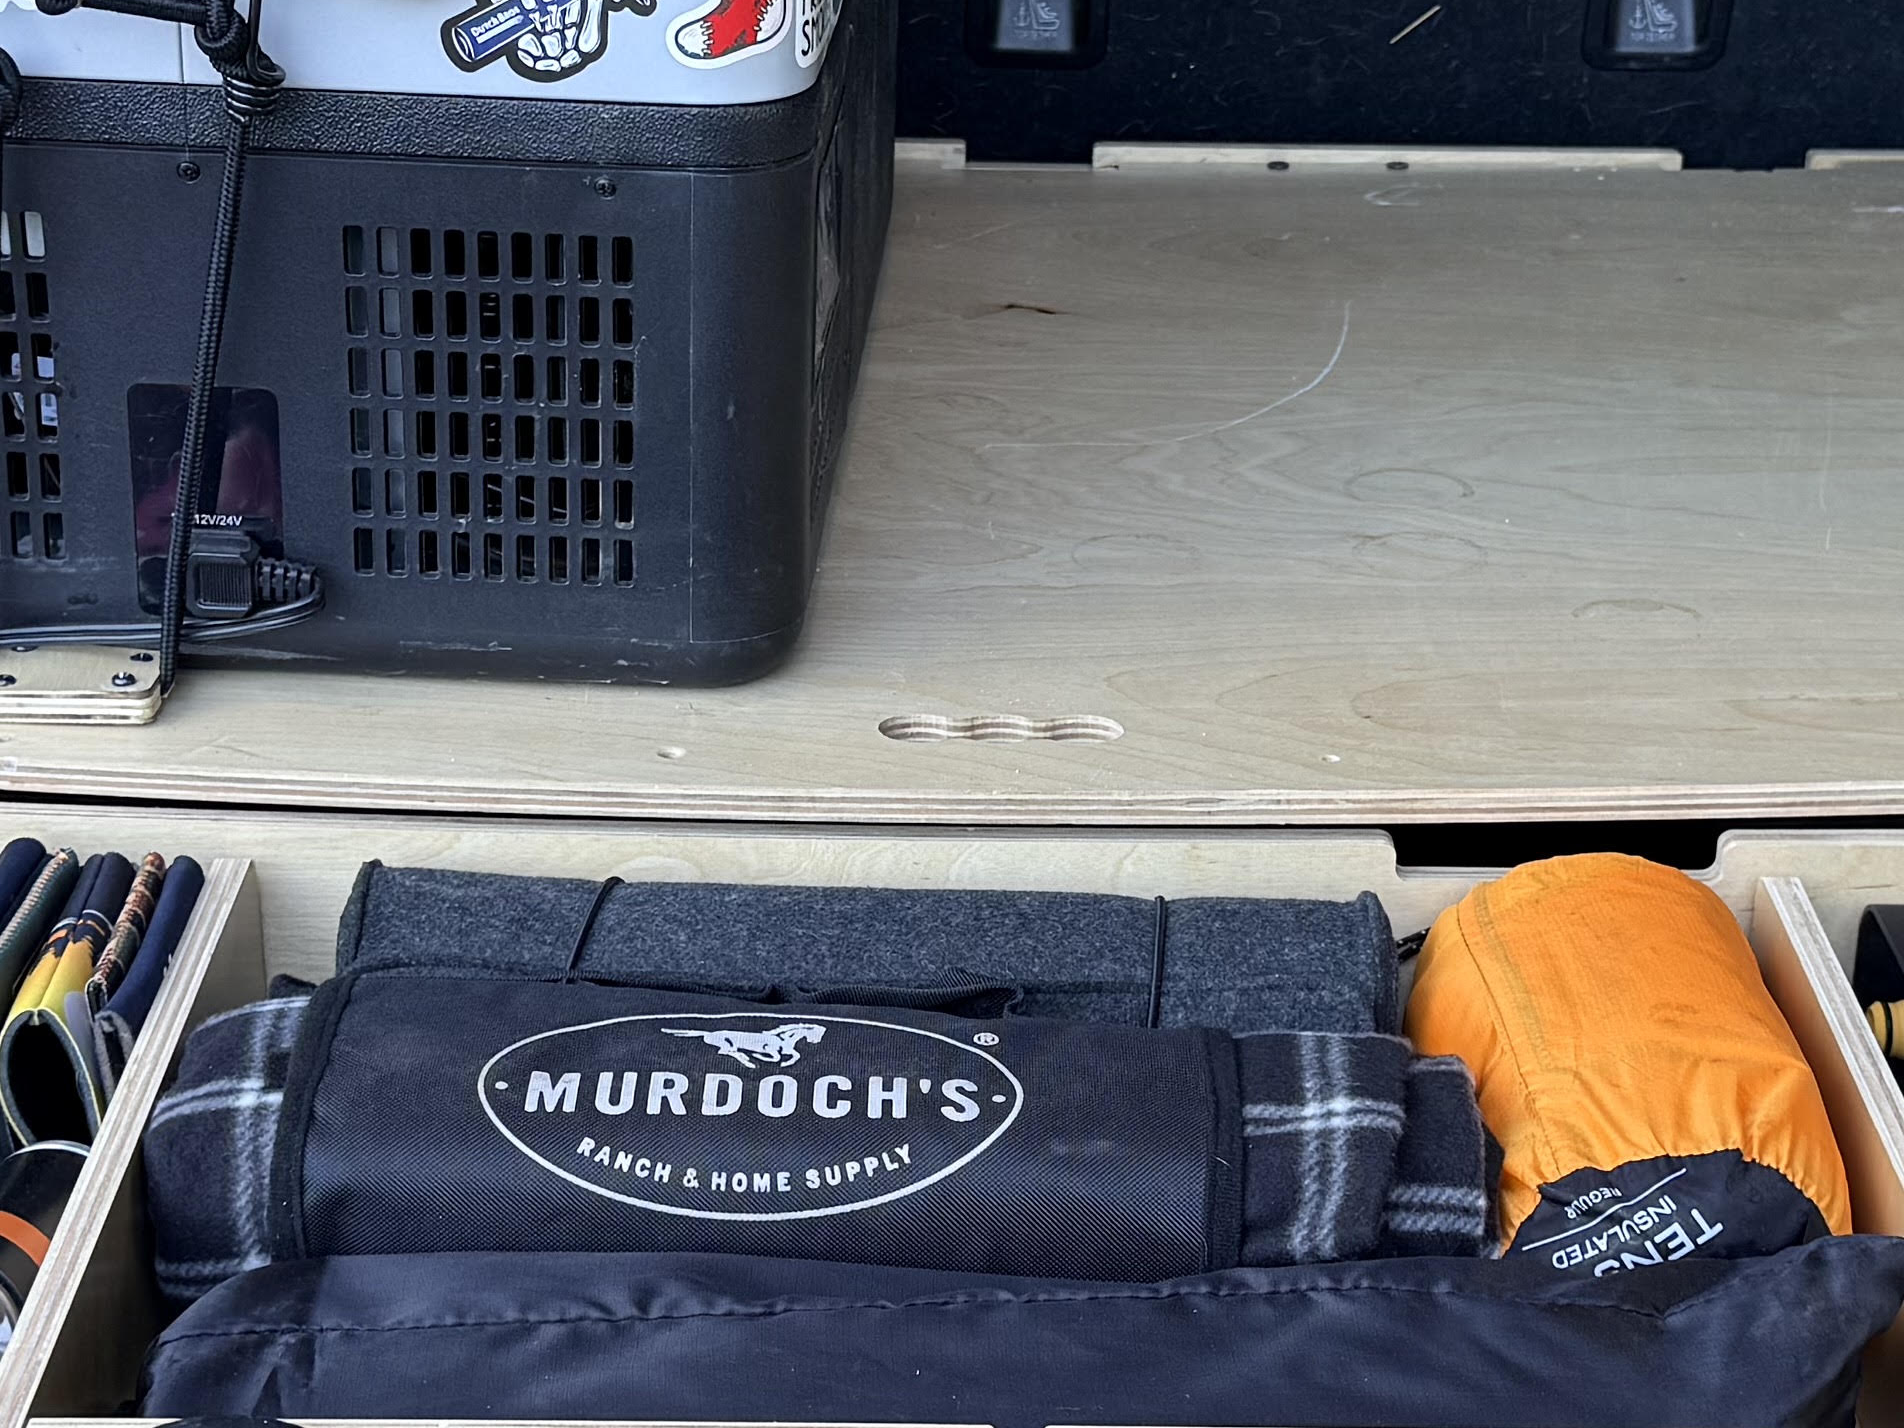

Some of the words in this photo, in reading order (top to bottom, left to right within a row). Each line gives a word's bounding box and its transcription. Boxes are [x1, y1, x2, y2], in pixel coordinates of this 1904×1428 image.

[524, 1070, 981, 1122] MURDOCH'S
[576, 1136, 670, 1184] RANCH
[682, 1167, 700, 1188] &
[711, 1170, 792, 1193] HOME
[804, 1144, 913, 1190] SUPPLY
[1551, 1194, 1678, 1270] INSULATED
